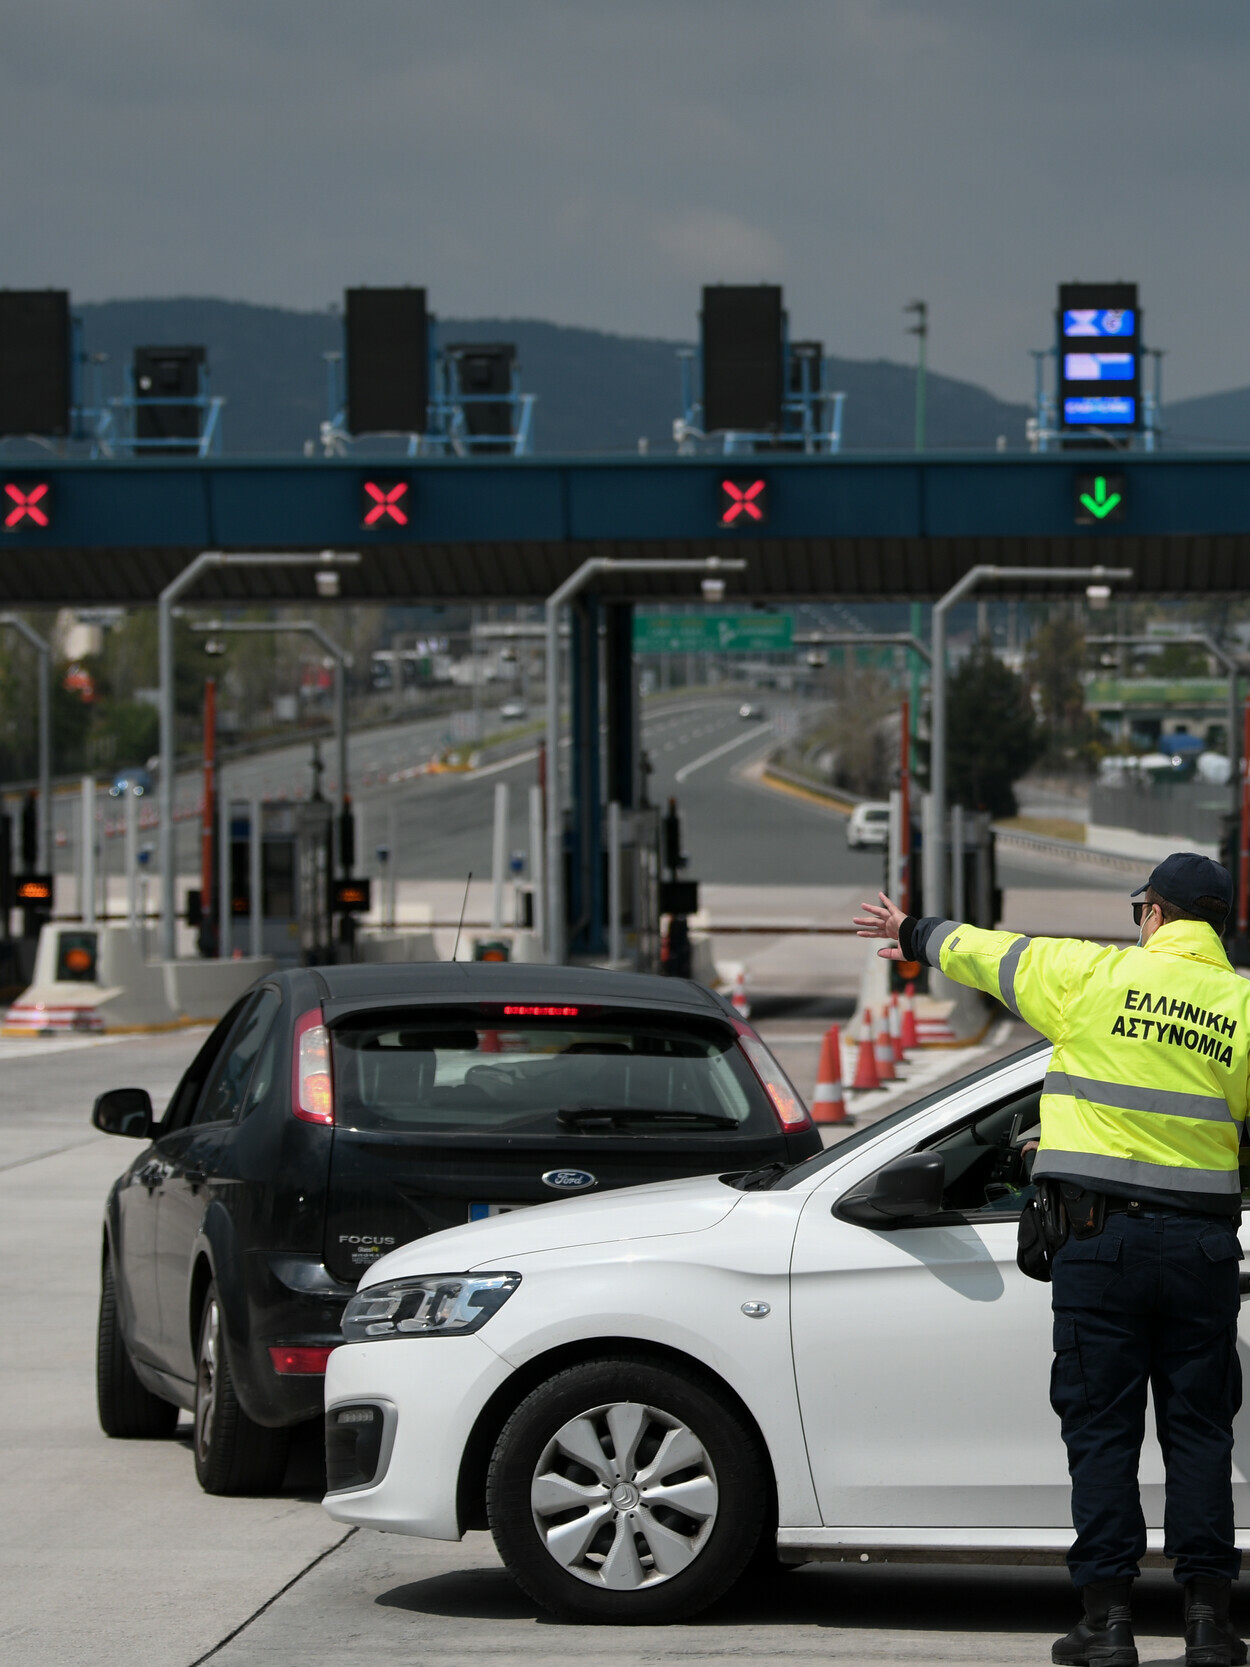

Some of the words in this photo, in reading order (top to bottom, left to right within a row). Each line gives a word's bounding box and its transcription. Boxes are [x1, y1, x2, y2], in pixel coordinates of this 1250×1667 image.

[1124, 989, 1237, 1039] ΕΛΛΗΝΙΚΗ
[1111, 1015, 1233, 1068] ΑΣΤΥΝΟΜΙΑ
[554, 1172, 585, 1185] Ford
[339, 1235, 395, 1245] FOCUS
